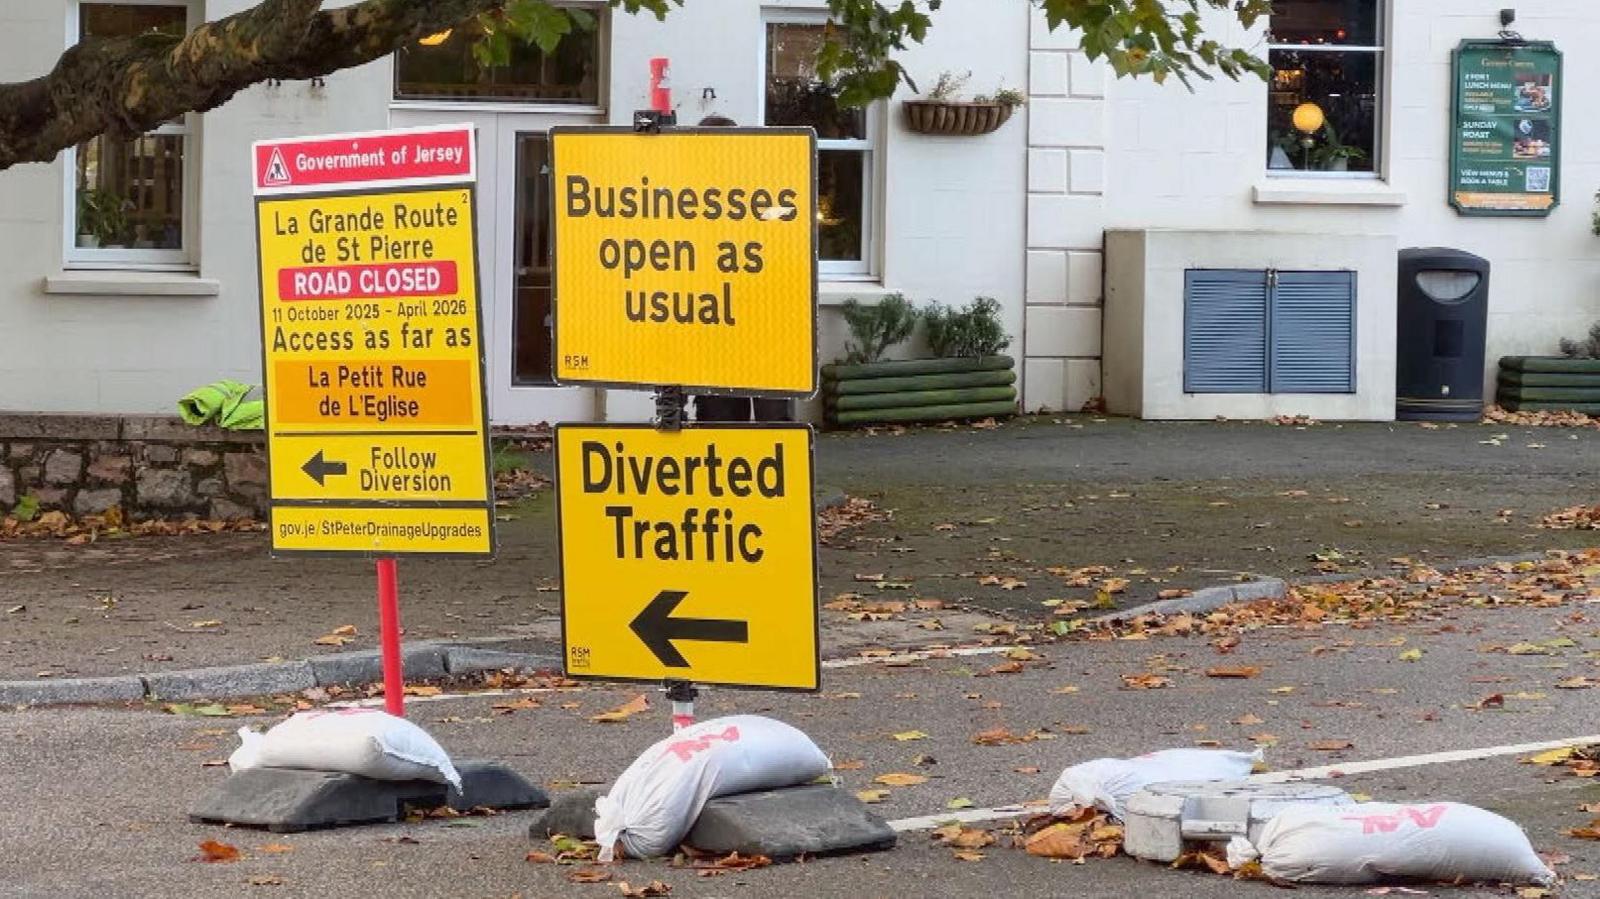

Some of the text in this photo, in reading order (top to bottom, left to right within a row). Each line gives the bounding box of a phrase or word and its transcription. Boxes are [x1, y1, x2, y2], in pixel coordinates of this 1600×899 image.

[1463, 121, 1497, 129] SUNDAY
[1463, 131, 1490, 139] ROAST
[295, 145, 463, 172] Government of Jersey
[566, 175, 798, 221] Businesses
[275, 203, 458, 235] La Grande Route
[302, 235, 433, 263] de St Pierre
[599, 238, 764, 279] open as
[294, 267, 441, 295] ROAD CLOSED
[273, 308, 282, 322] 11
[287, 305, 339, 321] October
[345, 304, 380, 320] 2025
[397, 301, 427, 319] April
[433, 300, 466, 315] 2026
[625, 282, 736, 326] usual
[272, 322, 472, 352] Access as far as
[308, 366, 427, 388] La Petit Rue
[319, 395, 419, 422] de L'Eglise
[371, 446, 436, 470] Follow
[582, 441, 785, 498] Diverted
[360, 468, 451, 492] Diversion
[279, 520, 482, 540] gov.je/StPeterDrainageUpgrades
[605, 506, 764, 563] Traffic
